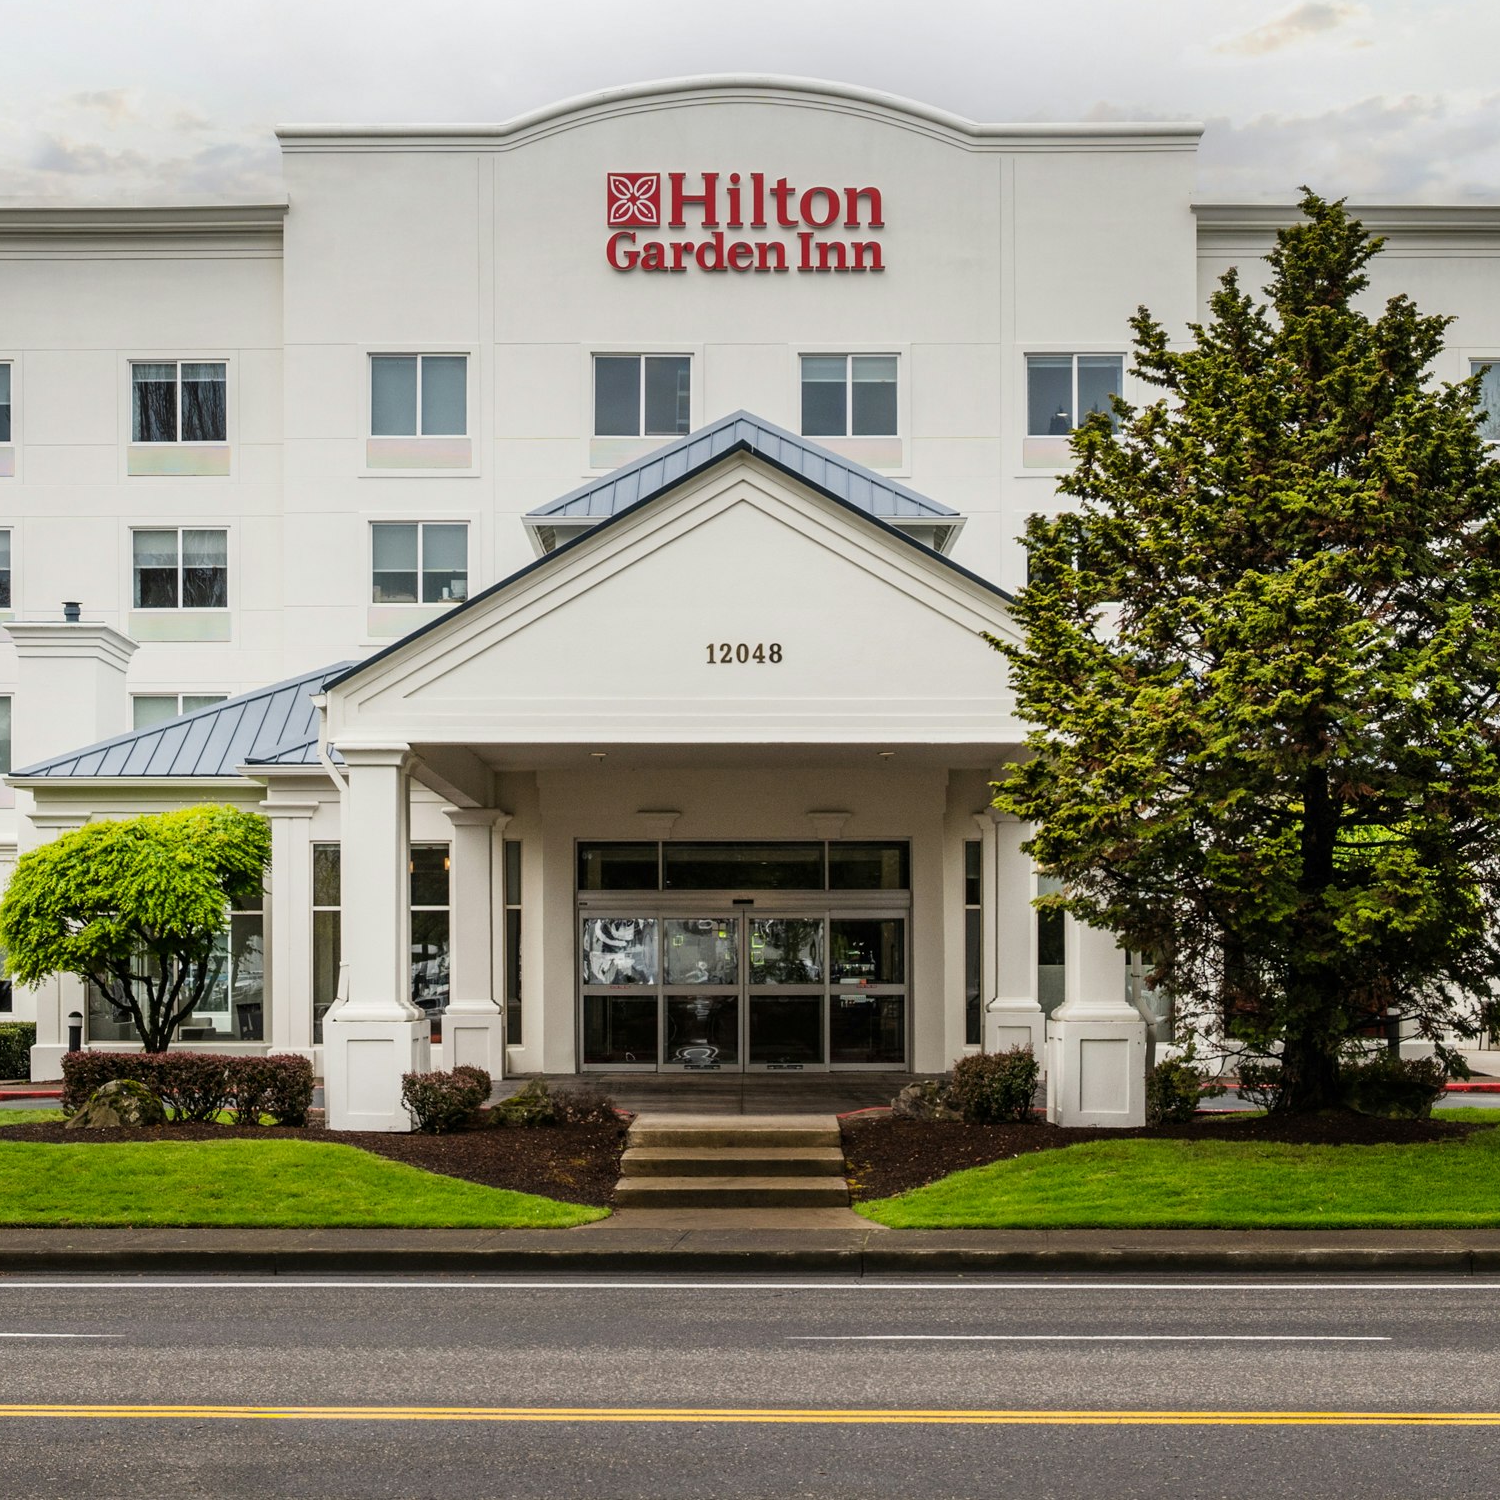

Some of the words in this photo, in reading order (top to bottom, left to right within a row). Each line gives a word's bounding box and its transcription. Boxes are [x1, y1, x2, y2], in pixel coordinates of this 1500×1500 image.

[667, 172, 885, 228] Hilton
[606, 231, 790, 271] Garden
[797, 231, 886, 271] Inn
[706, 642, 783, 664] 12048
